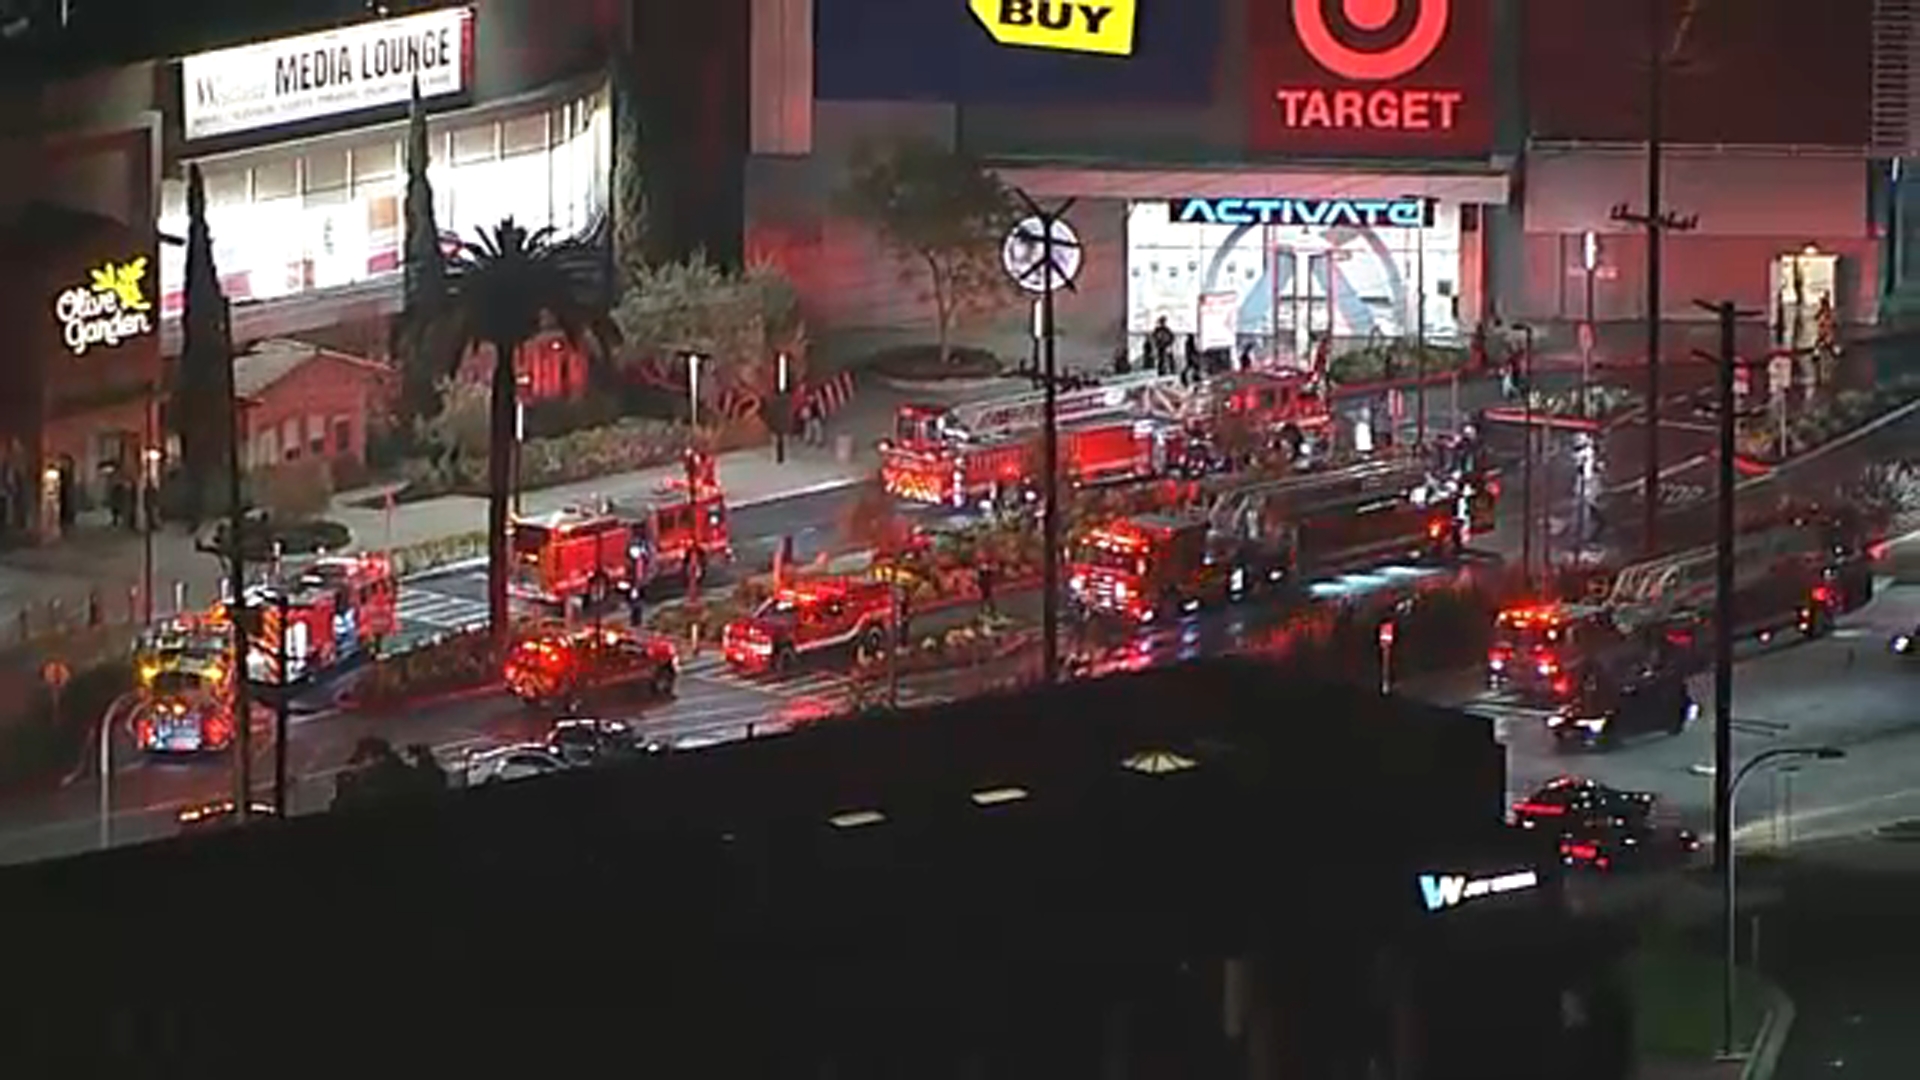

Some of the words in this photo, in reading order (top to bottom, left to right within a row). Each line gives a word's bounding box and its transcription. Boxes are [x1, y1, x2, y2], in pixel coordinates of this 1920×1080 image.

[999, 0, 1113, 34] BUY
[275, 45, 352, 97] MEDIA
[361, 28, 451, 80] LOUNGE
[1277, 89, 1461, 128] TARGET
[56, 287, 118, 321] Olive
[65, 308, 151, 355] Garden
